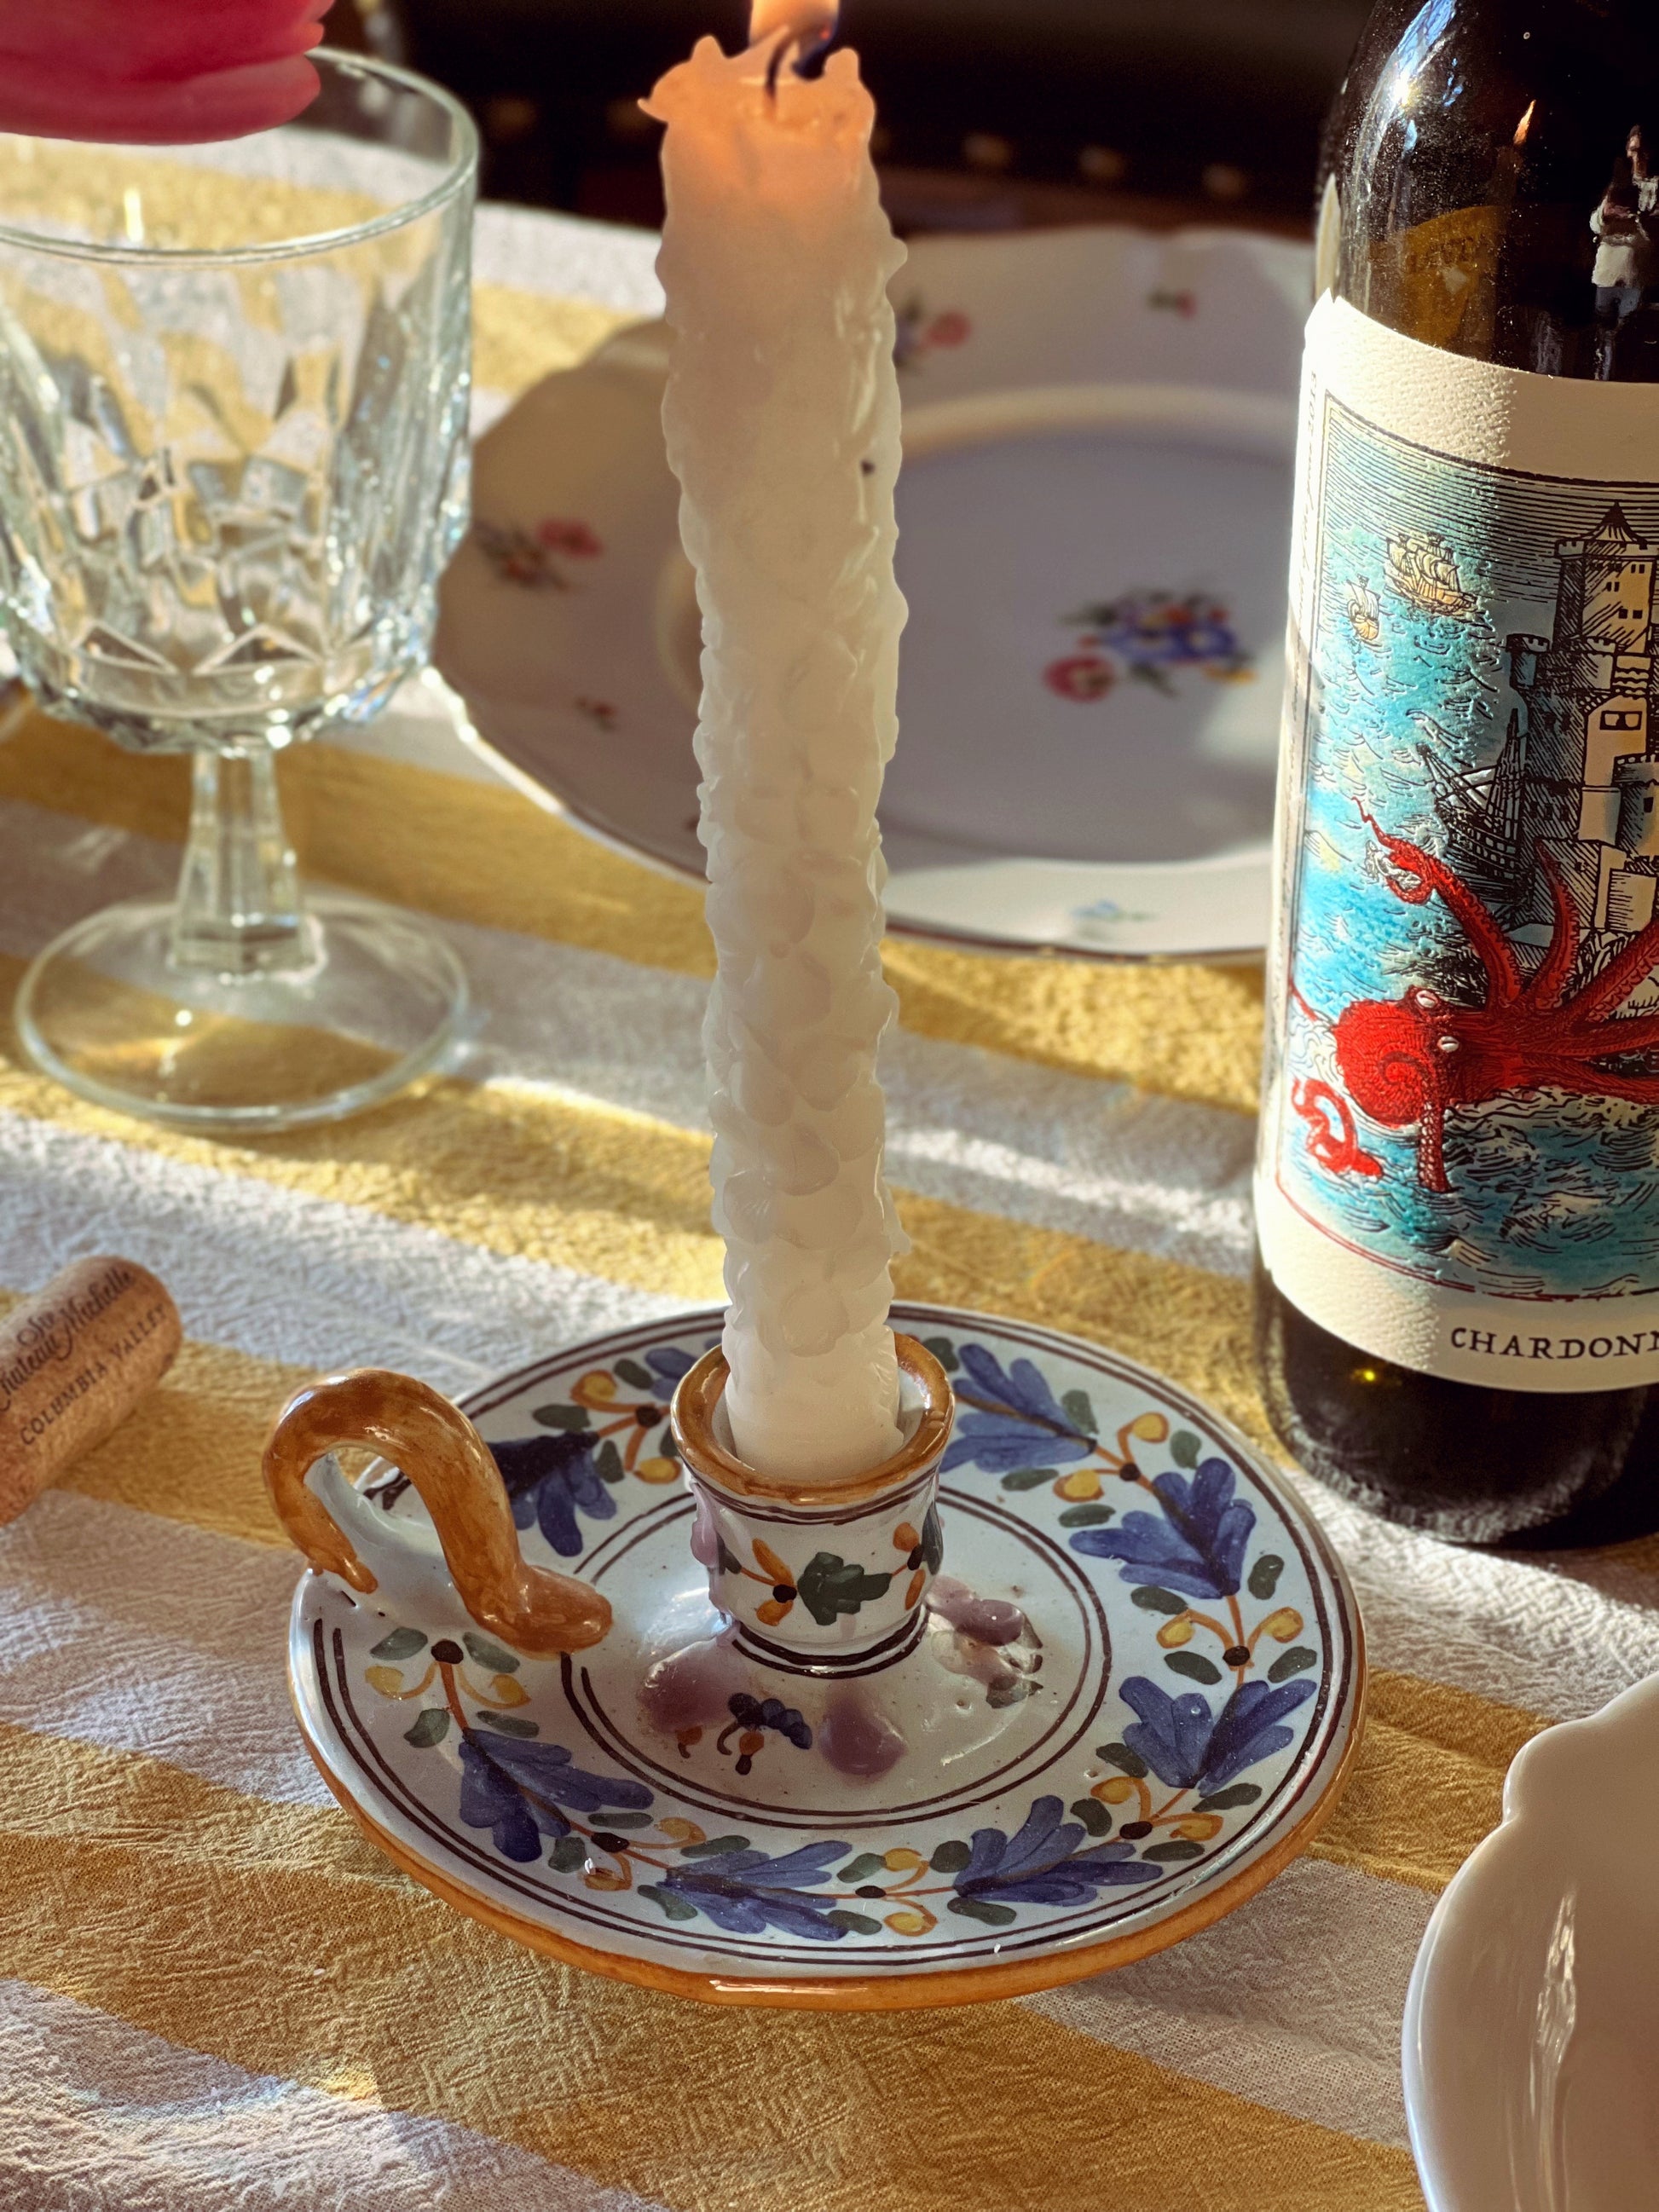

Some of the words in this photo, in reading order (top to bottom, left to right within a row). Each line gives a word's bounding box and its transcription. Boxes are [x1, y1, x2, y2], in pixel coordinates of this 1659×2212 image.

[1307, 370, 1317, 436] 2013
[57, 1268, 133, 1362] Michelle
[20, 1360, 108, 1445] COLUMBIA
[110, 1303, 167, 1361] VALLEY
